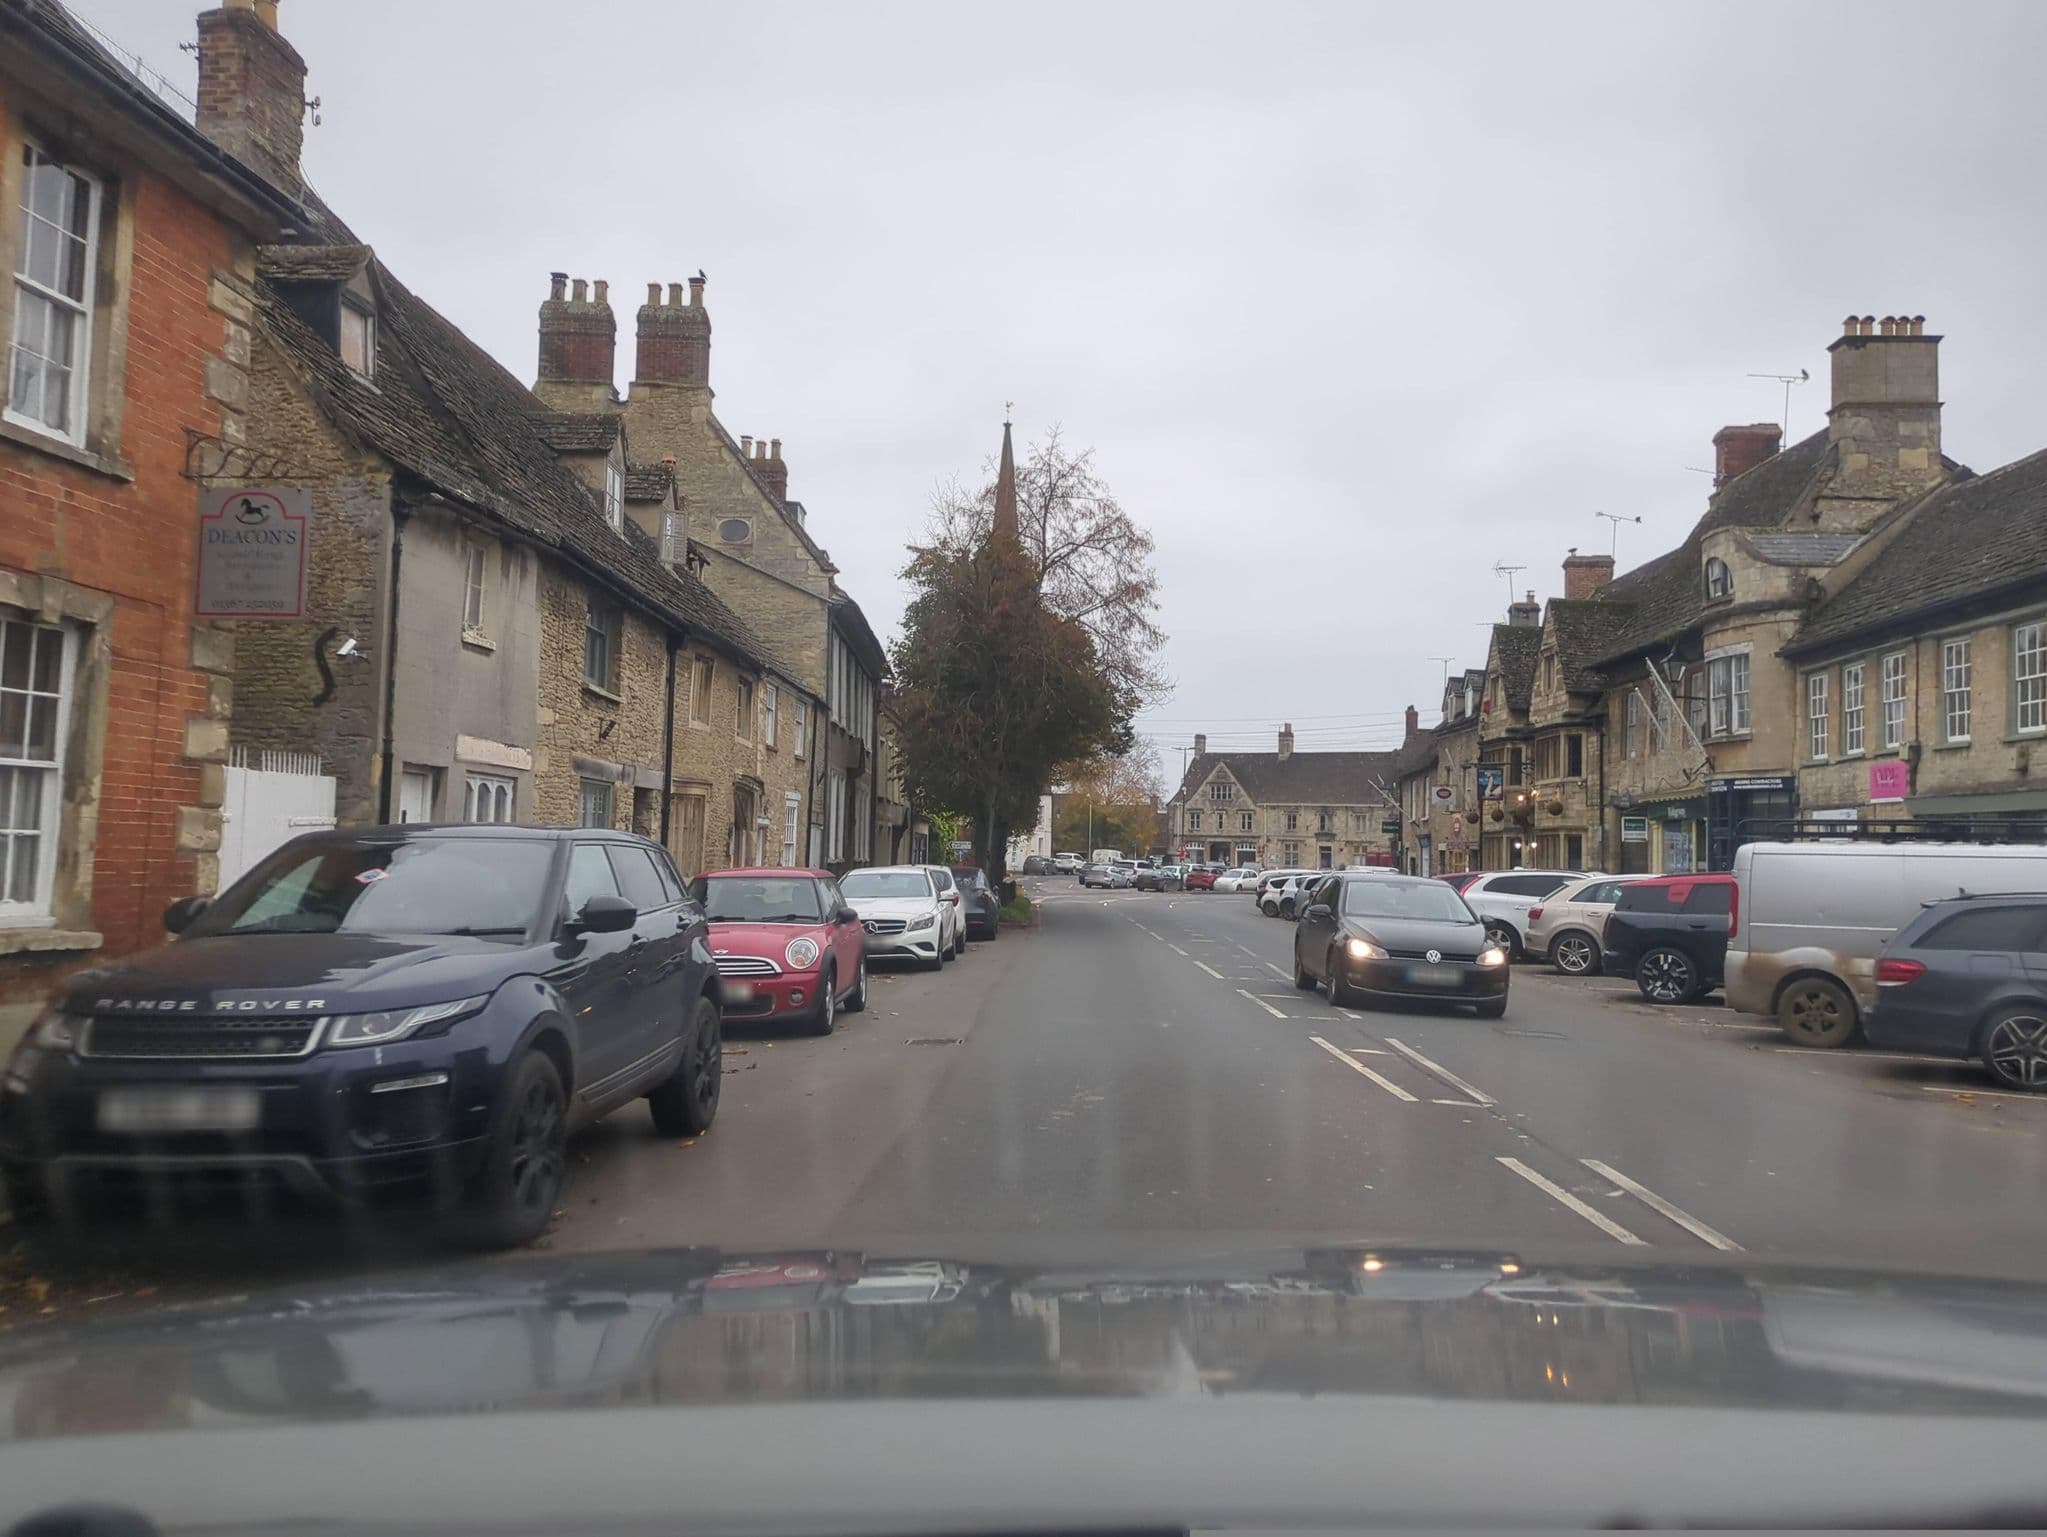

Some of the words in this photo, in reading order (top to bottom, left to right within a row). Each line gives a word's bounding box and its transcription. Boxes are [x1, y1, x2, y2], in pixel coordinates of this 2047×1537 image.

[207, 528, 297, 546] DEACON'S
[95, 998, 199, 1012] RANGE
[215, 998, 327, 1011] ROVER
